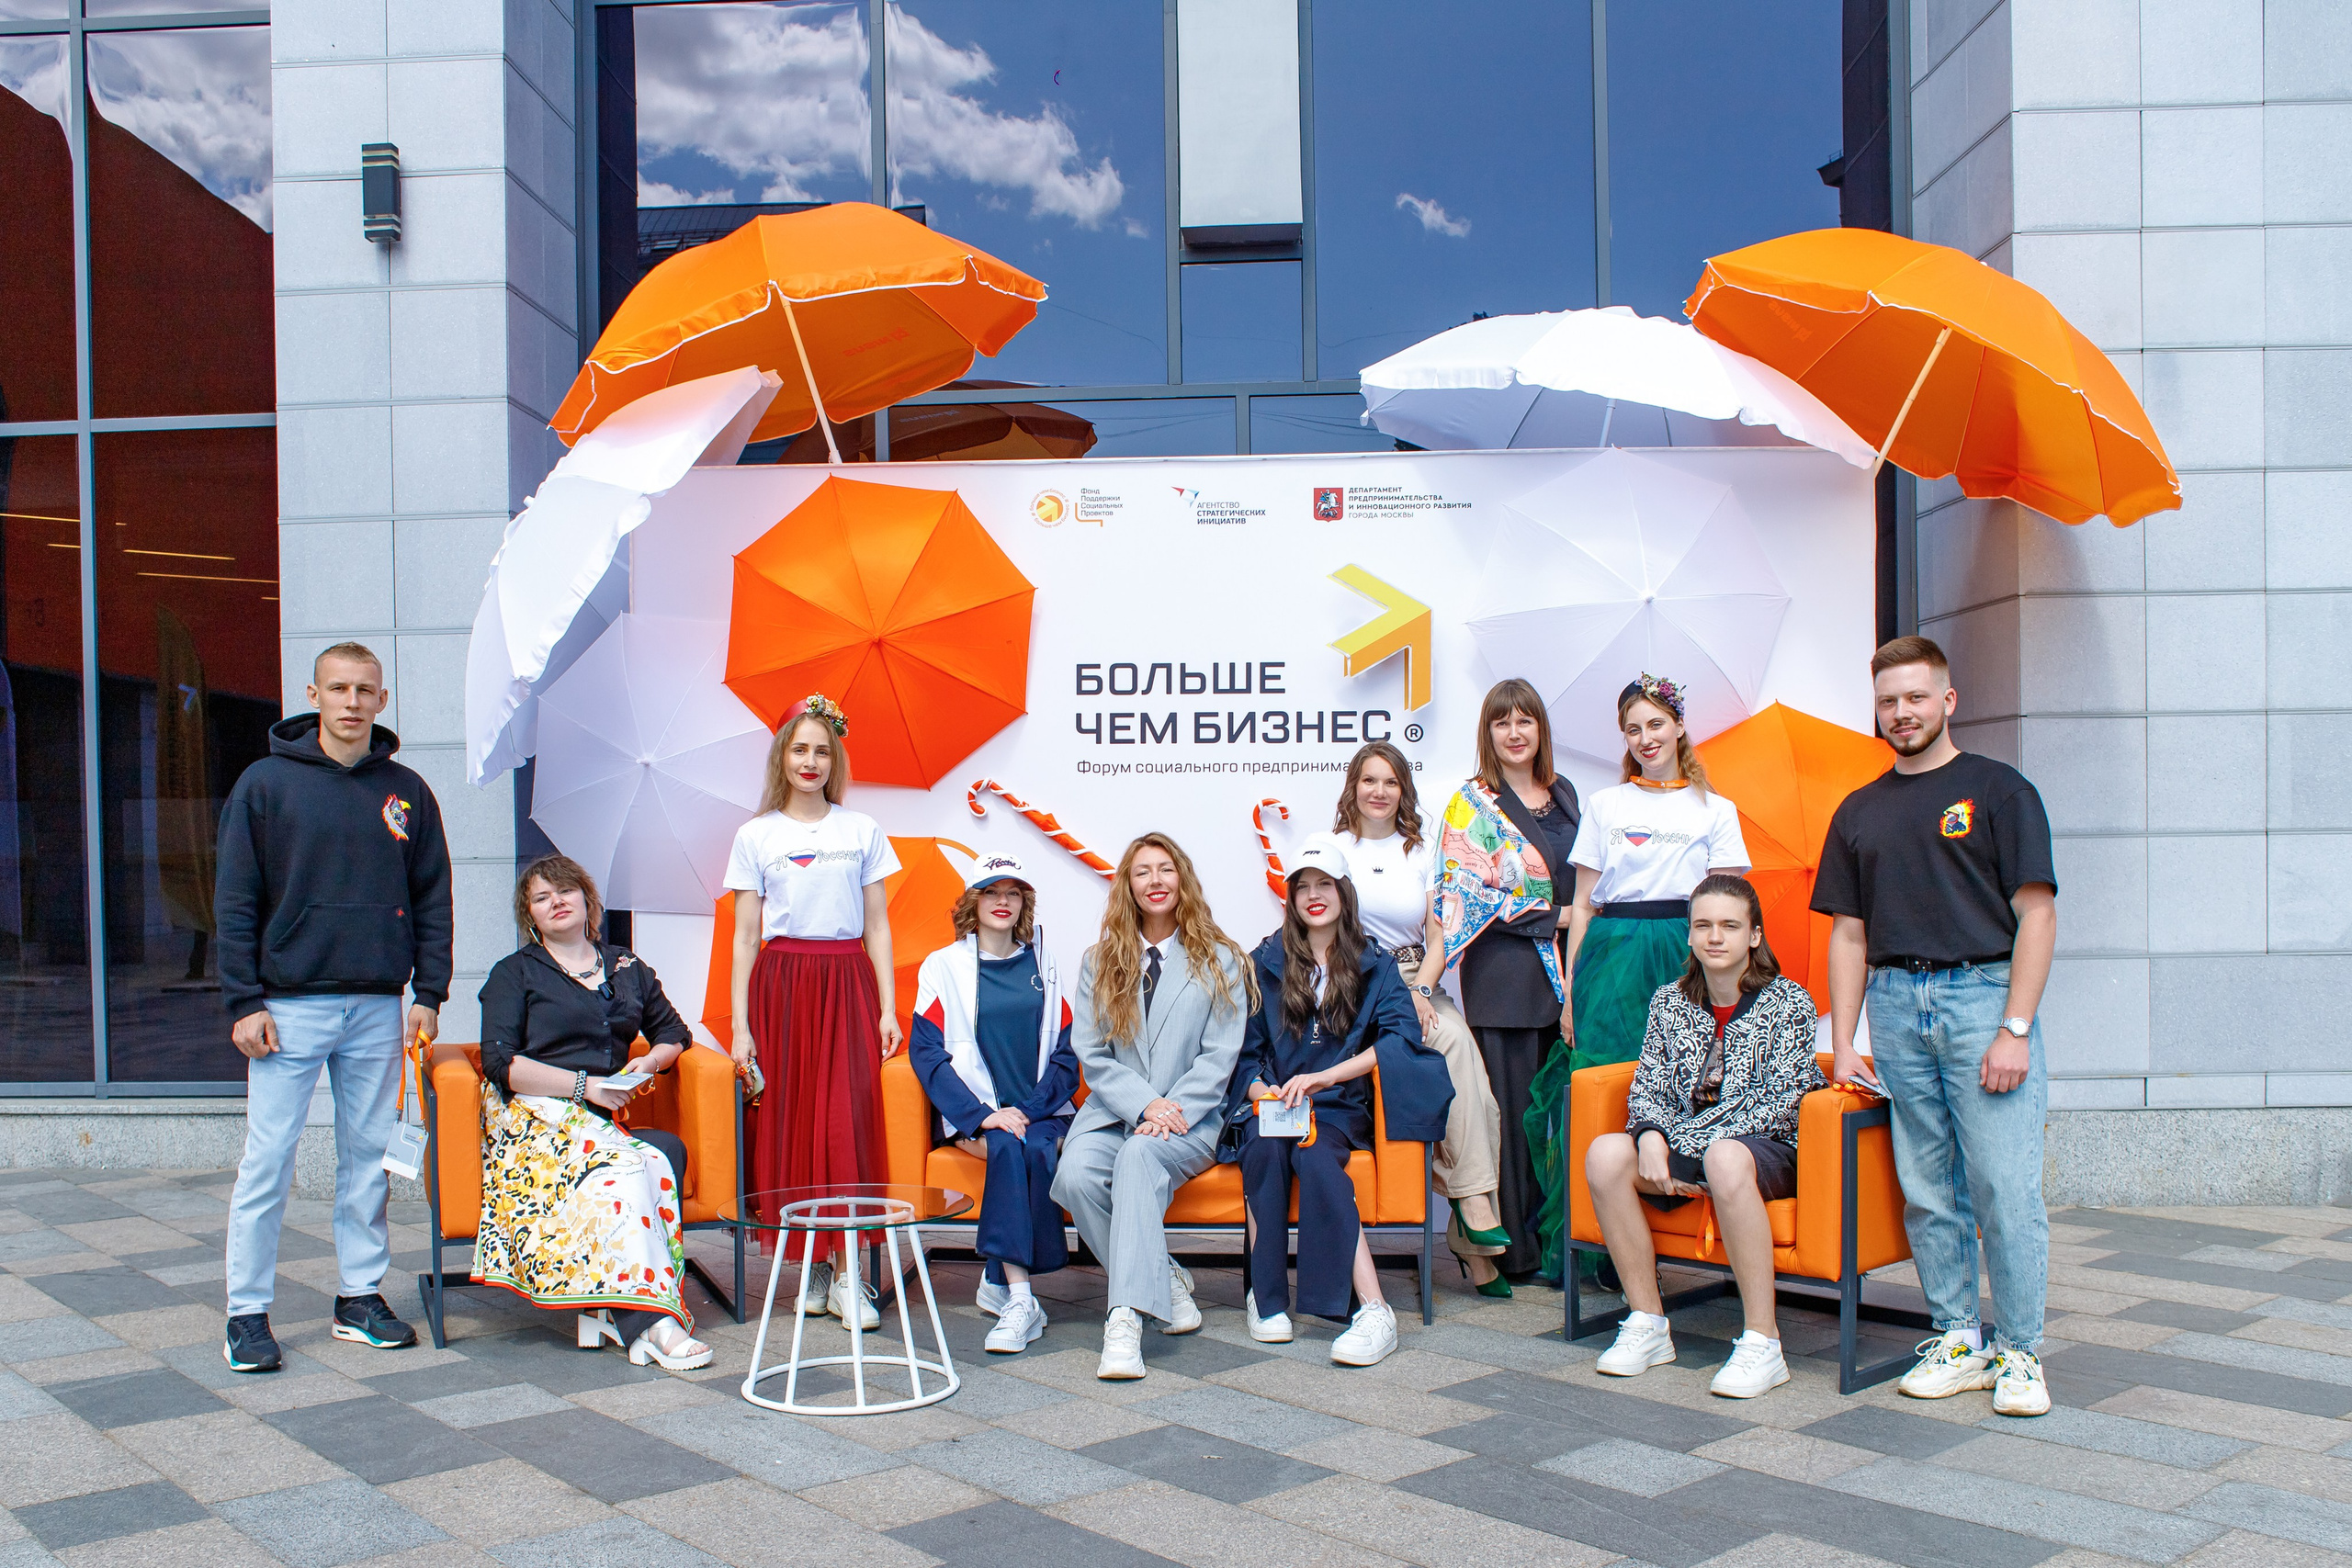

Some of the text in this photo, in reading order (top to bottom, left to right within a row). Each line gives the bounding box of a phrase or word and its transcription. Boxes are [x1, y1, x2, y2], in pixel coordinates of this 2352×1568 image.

[1197, 517, 1247, 525] ИНИЦИАТИВ
[1075, 661, 1286, 695] БОЛЬШЕ
[1075, 711, 1178, 744] ЧЕМ
[1193, 709, 1392, 744] БИЗНЕС
[1077, 760, 1132, 776] Форум
[1136, 762, 1238, 774] социального
